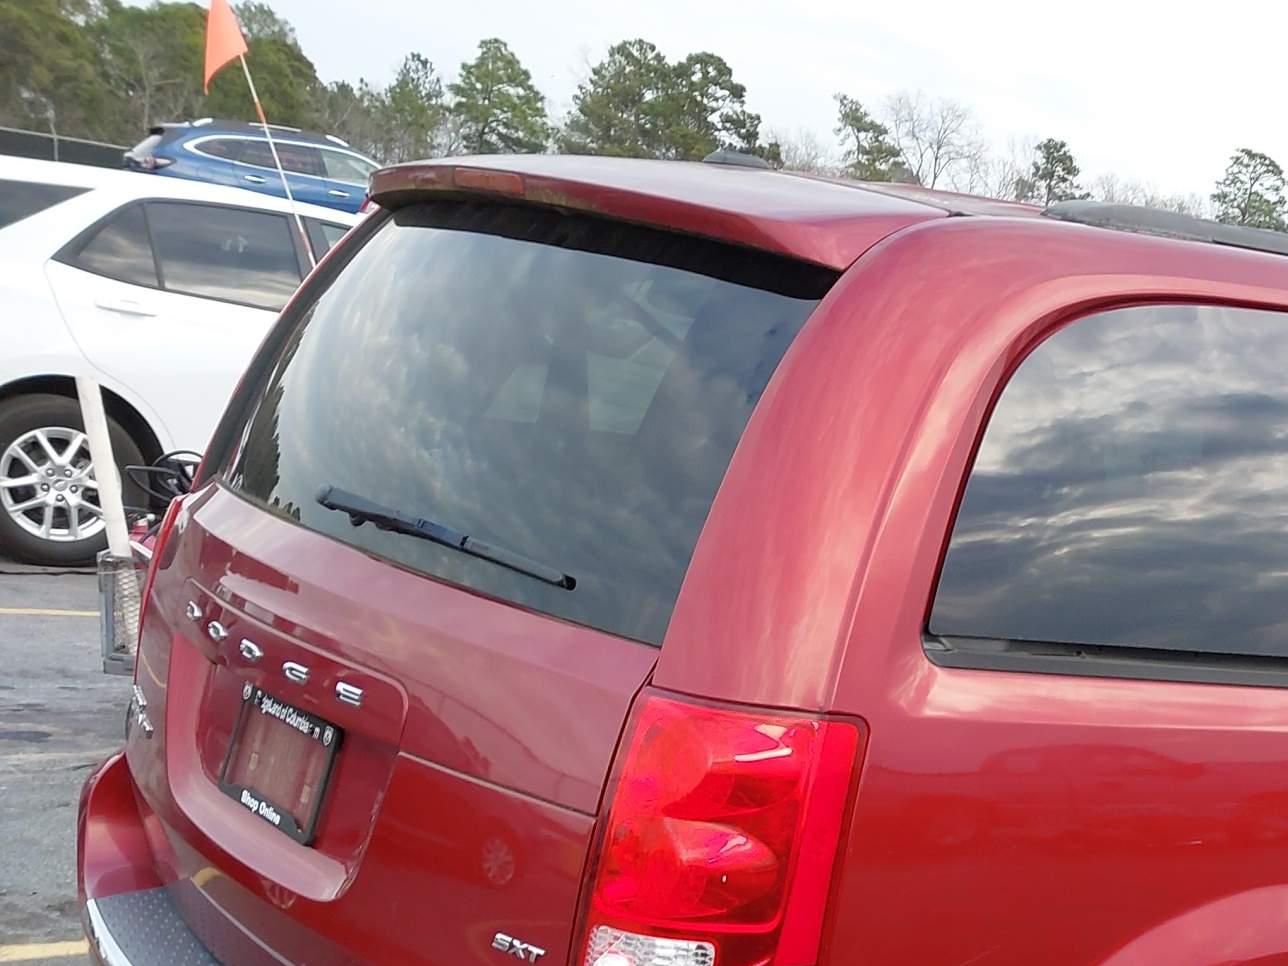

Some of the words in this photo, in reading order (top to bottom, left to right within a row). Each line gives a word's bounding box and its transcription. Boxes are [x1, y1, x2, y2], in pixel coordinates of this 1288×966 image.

[185, 600, 364, 706] DODGE
[241, 790, 259, 812] Shop
[259, 801, 281, 825] Online
[491, 932, 546, 966] SXT
